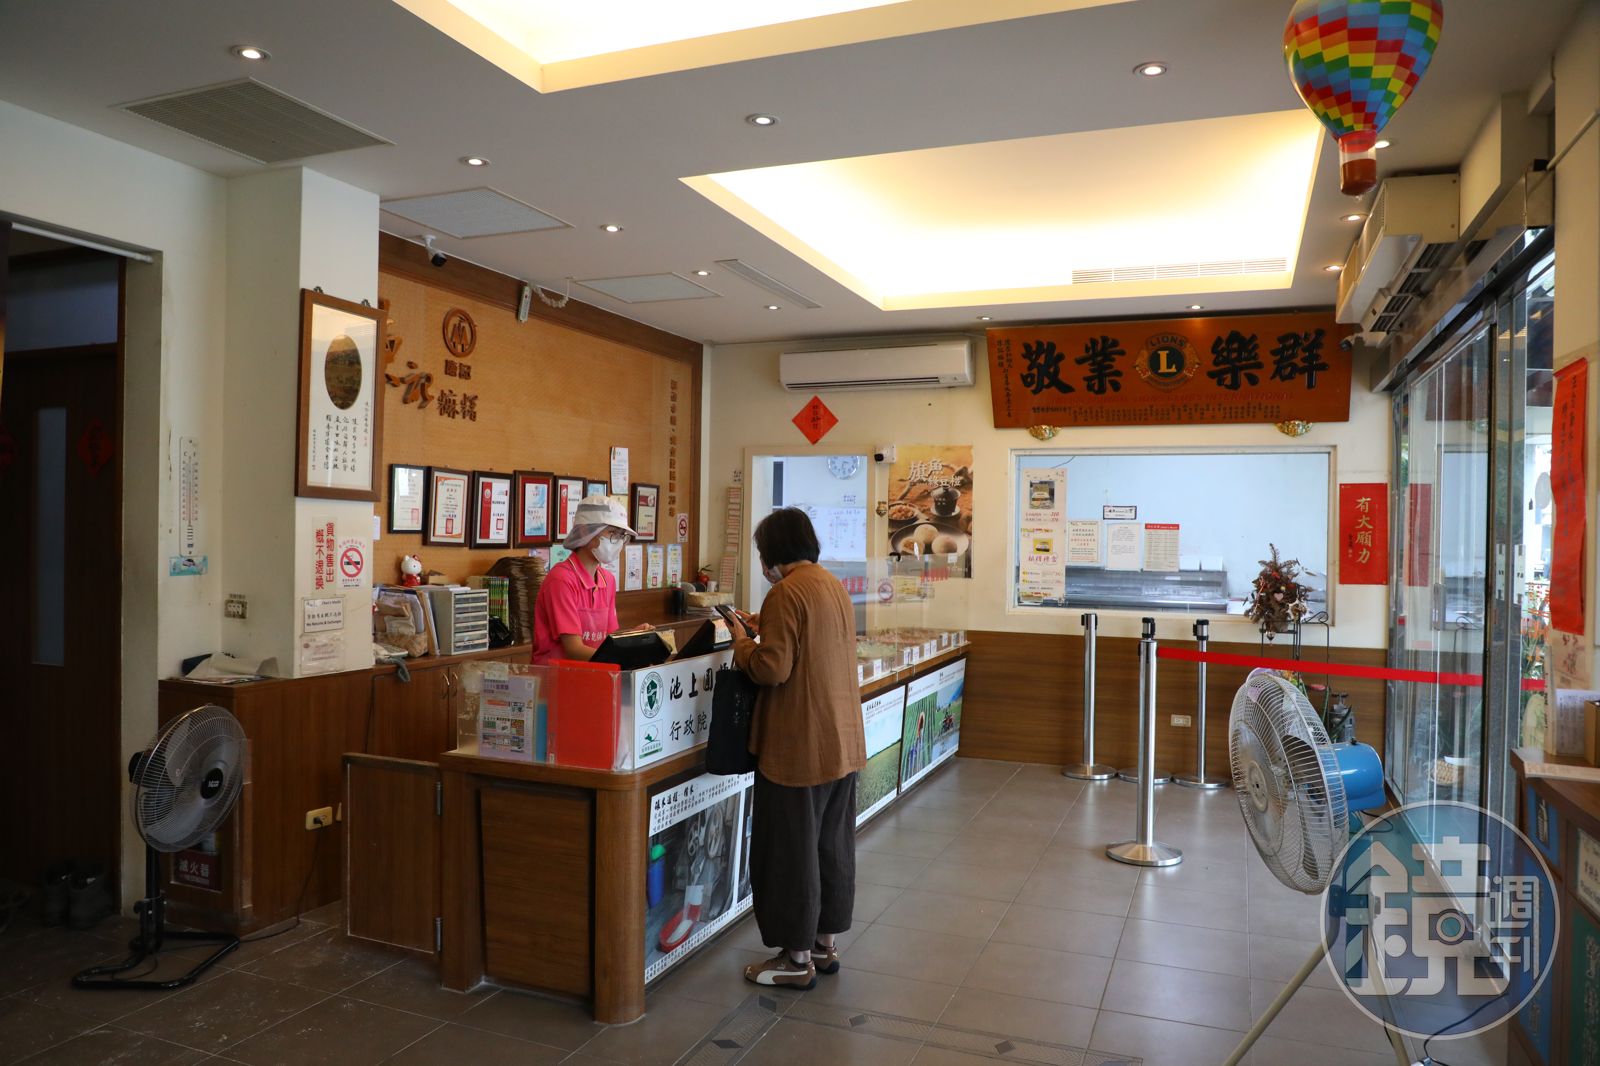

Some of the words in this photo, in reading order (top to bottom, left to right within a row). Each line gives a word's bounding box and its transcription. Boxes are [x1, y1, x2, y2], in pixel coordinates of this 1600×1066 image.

[1020, 335, 1127, 395] 敬業
[1206, 329, 1331, 391] 樂群
[1150, 336, 1186, 347] LIONS
[1158, 350, 1177, 373] L
[325, 522, 335, 583] 貨物售出
[1355, 496, 1374, 564] 有大願力
[315, 528, 325, 590] 概不退換
[669, 662, 731, 701] 池上圓
[669, 711, 708, 742] 行政院
